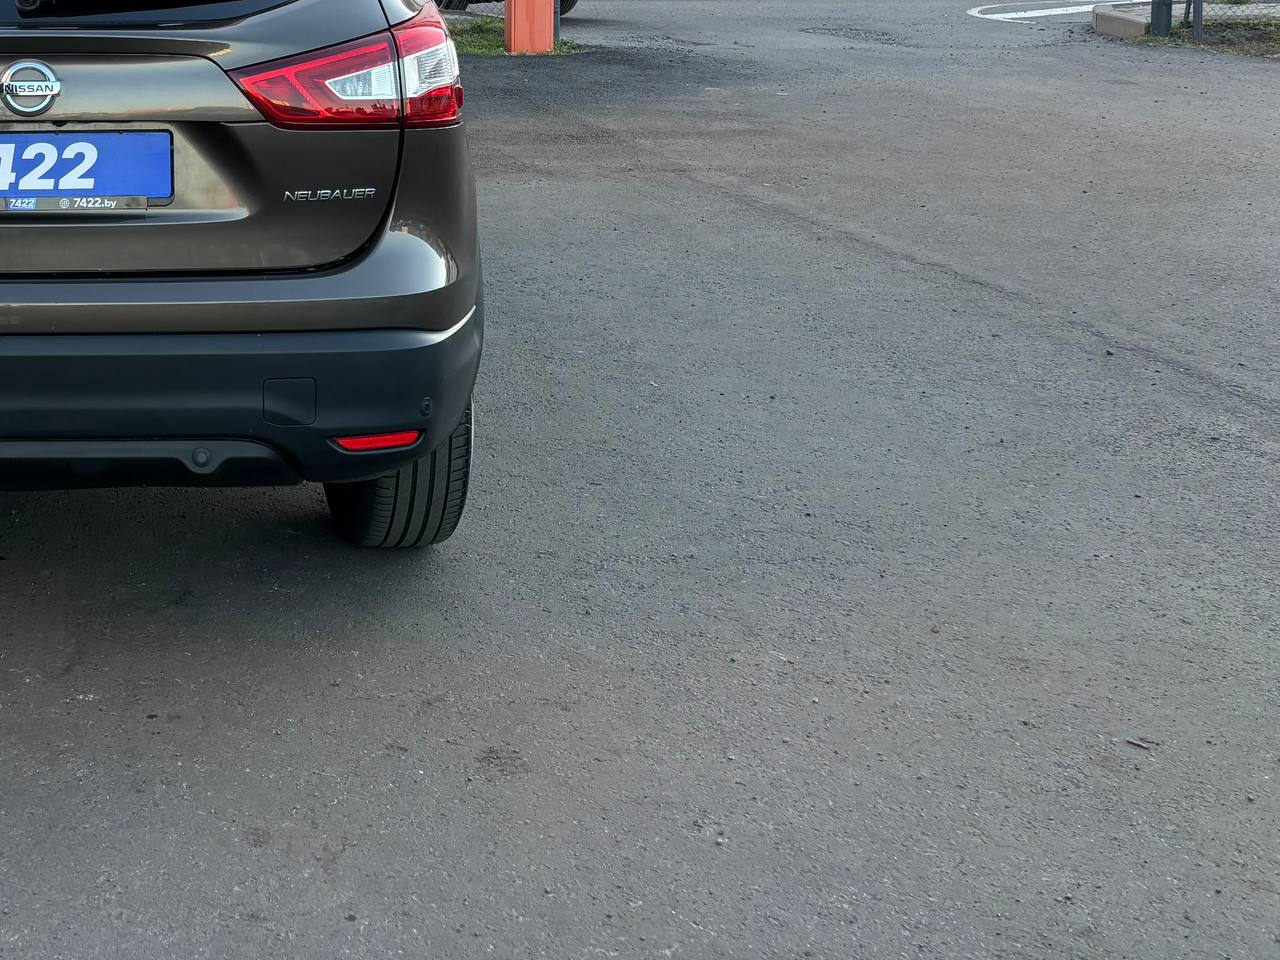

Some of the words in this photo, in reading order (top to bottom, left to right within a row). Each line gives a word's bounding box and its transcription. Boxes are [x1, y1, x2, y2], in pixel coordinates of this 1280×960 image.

[4, 84, 54, 94] NISSAN
[283, 188, 376, 201] NEUBAUER
[9, 199, 35, 209] 7422
[73, 198, 117, 209] 7422.by
